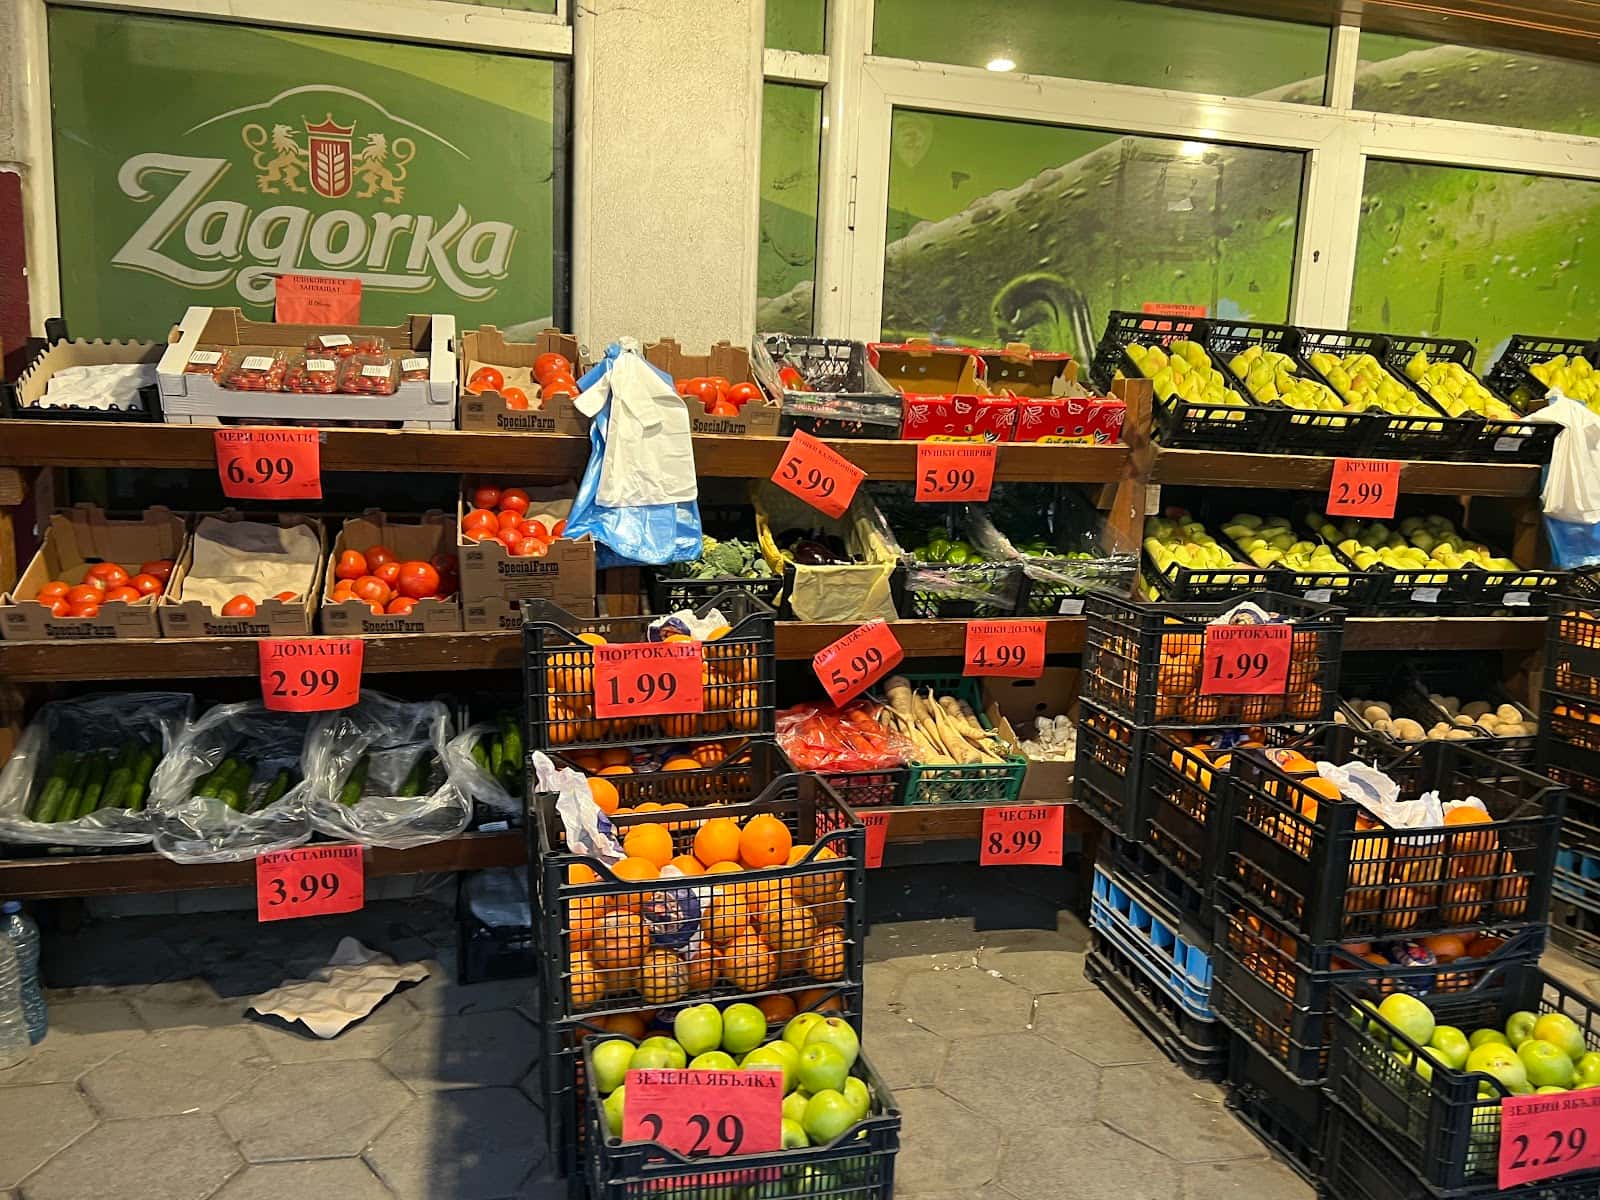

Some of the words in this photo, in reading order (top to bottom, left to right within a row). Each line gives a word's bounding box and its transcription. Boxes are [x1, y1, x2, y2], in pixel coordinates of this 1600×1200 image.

[112, 153, 517, 306] Zagorka
[497, 414, 555, 430] SpecialFarm
[693, 419, 746, 434] SpecialFarm
[218, 432, 253, 442] ЧЕРИ
[257, 432, 313, 443] ДОМАТИ
[921, 449, 955, 457] ЧУШКИ
[226, 456, 294, 485] 6.99
[1345, 461, 1389, 473] КРУШИ
[782, 457, 835, 498] 5.99
[923, 468, 975, 493] 5.99
[1336, 482, 1383, 505] 2.99
[498, 560, 559, 576] SpecialFarm
[203, 622, 271, 635] SpecialFarm
[361, 620, 424, 633] SpecialFarm
[971, 625, 1006, 634] ЧУШКИ
[1008, 625, 1042, 634] ДОЛМА
[1211, 629, 1288, 641] ПОРТОКАЛИ
[271, 643, 351, 658] ДОМАТИ
[600, 646, 695, 662] ПОРТОКАЛИ
[972, 645, 1026, 668] 4.99
[831, 647, 883, 694] 5.99
[1211, 653, 1269, 680] 1.99
[270, 669, 339, 697] 2.99
[607, 672, 677, 706] 1.99
[999, 809, 1047, 822] ЧЕСЪН
[988, 830, 1042, 855] 8.99
[262, 847, 358, 865] КРАСТАВИЦИ
[269, 873, 340, 906] 3.99
[636, 1072, 702, 1086] ЗЕЛЕНА
[706, 1073, 777, 1088] ЯБЪЛКА
[1509, 1101, 1560, 1117] ЗЕЛЕНИ
[638, 1113, 744, 1158] 2.29
[1508, 1127, 1588, 1170] 2.29
